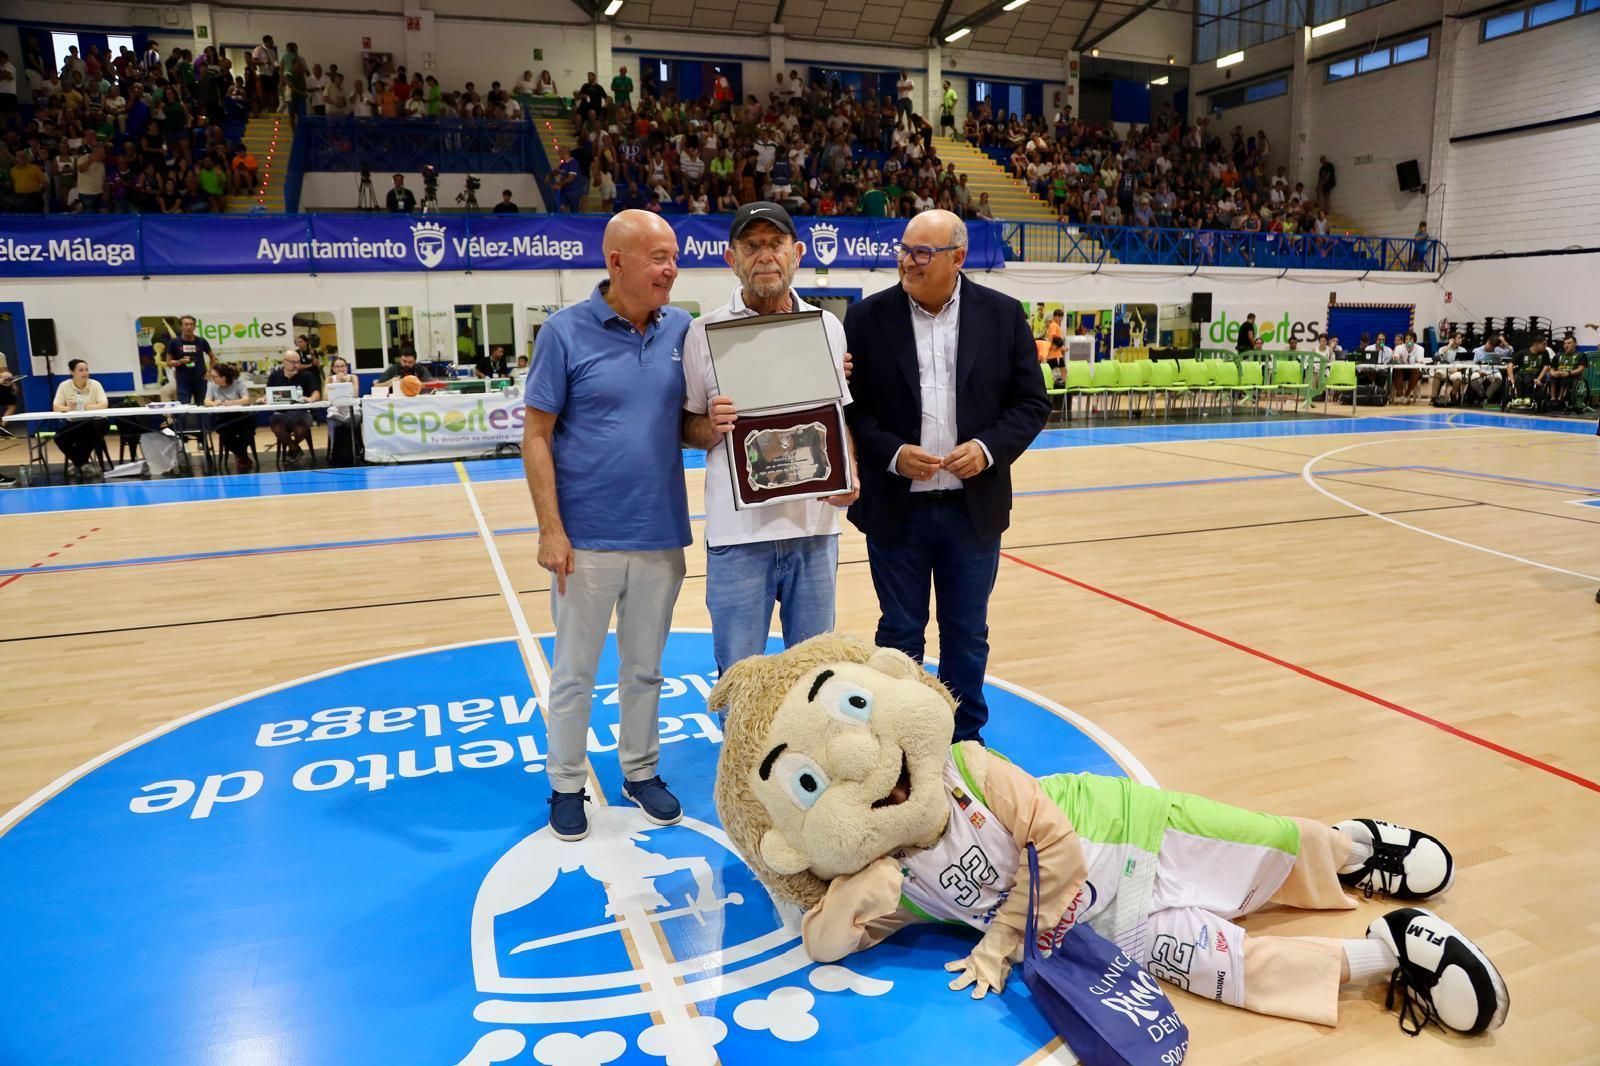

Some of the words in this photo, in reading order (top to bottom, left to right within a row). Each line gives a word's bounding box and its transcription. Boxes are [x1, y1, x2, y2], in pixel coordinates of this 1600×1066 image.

[256, 238, 406, 264] Ayuntamiento
[452, 235, 584, 261] Vélez-Málaga
[1209, 311, 1319, 344] deortes
[373, 399, 526, 444] deportes
[129, 770, 264, 820] de
[939, 845, 999, 908] 32
[1406, 923, 1446, 947] FLM
[1216, 970, 1226, 1000] PALDING
